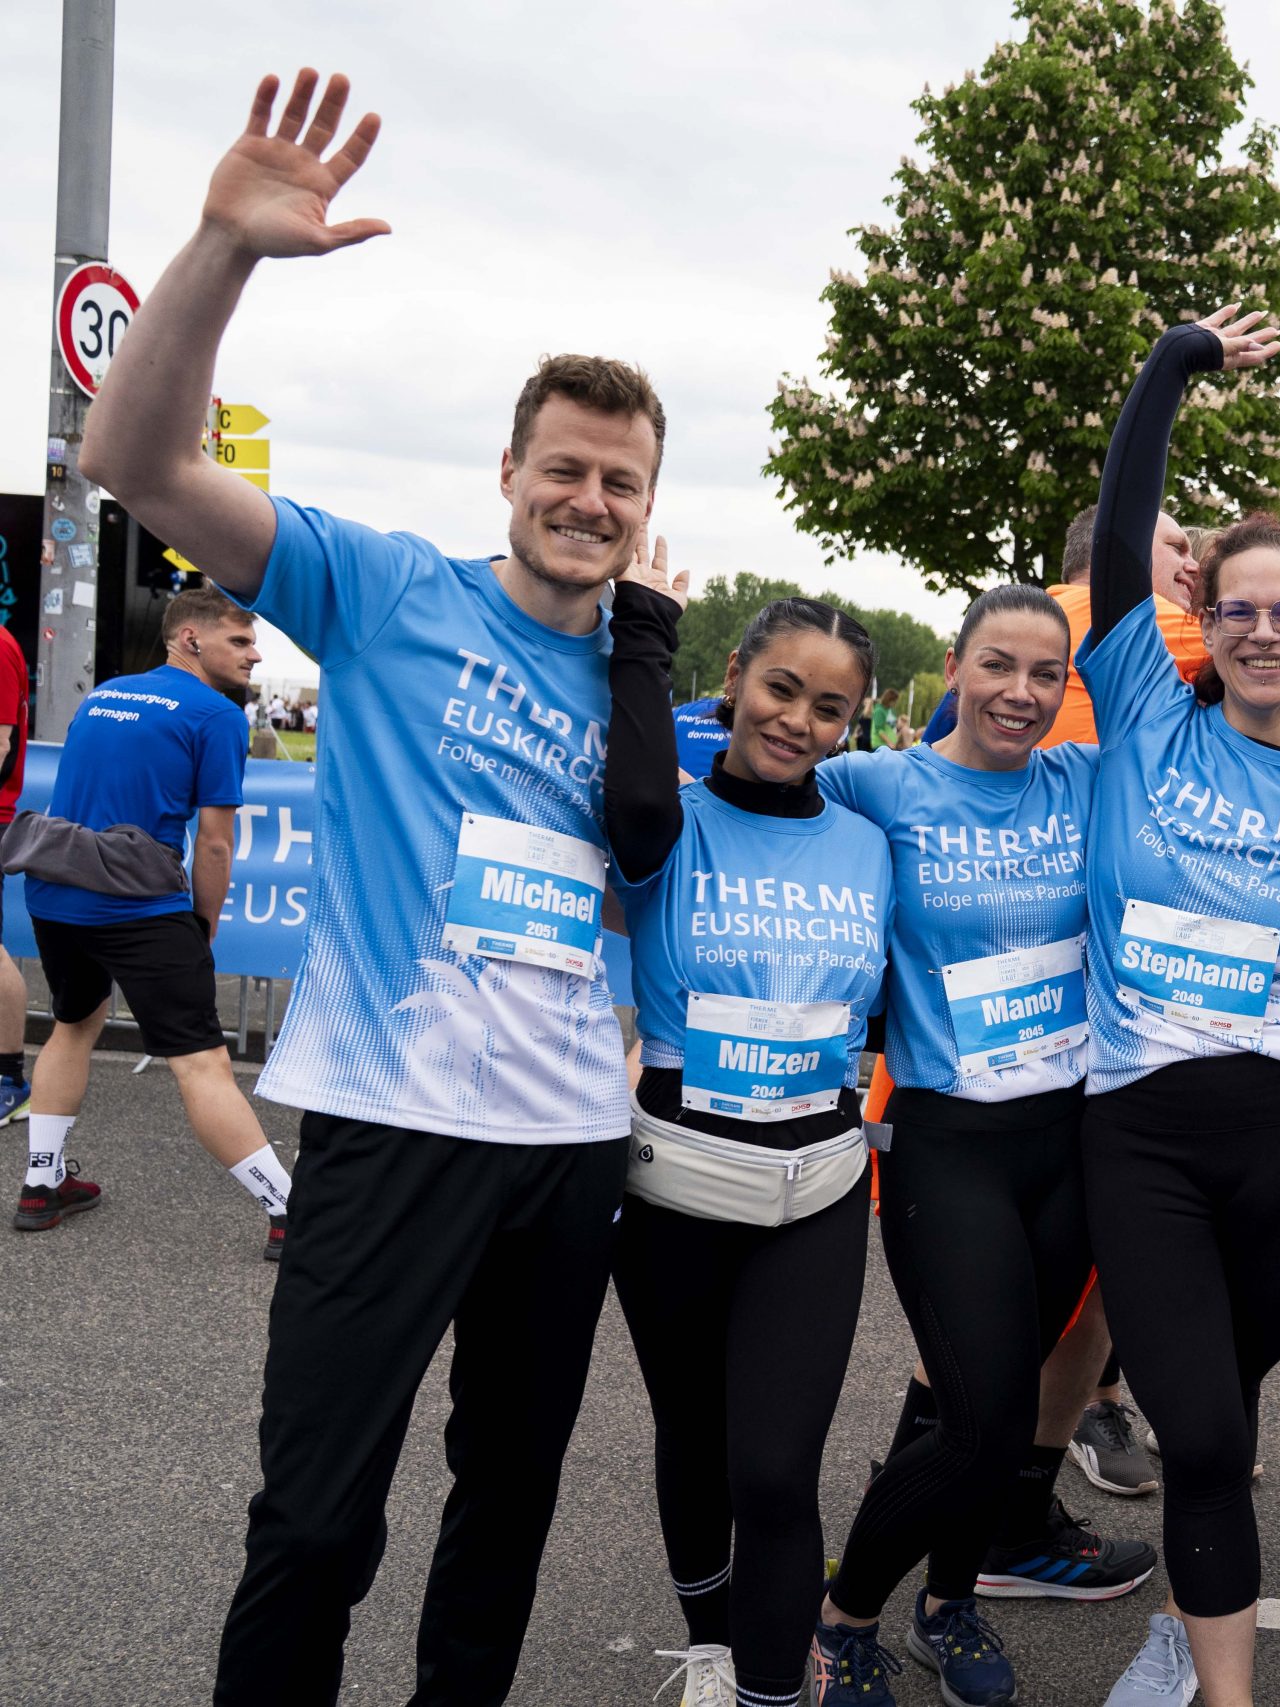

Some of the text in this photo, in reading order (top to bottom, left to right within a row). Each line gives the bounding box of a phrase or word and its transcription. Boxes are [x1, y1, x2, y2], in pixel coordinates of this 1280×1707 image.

[80, 300, 129, 359] 30
[88, 706, 139, 721] dormagen
[437, 736, 498, 773] Folge
[501, 763, 535, 788] mir
[536, 776, 568, 801] ins
[909, 813, 1082, 857] THERME
[1135, 824, 1176, 860] Folge
[1179, 852, 1212, 876] mir
[1215, 864, 1242, 888] ins
[480, 866, 596, 924] Michael
[692, 870, 877, 925] THERME
[923, 891, 973, 911] Folge
[977, 888, 1005, 906] mir
[1008, 887, 1032, 903] ins
[525, 921, 559, 940] 2051
[691, 912, 879, 953] EUSKIRCHEN
[695, 944, 748, 967] Folge
[753, 948, 783, 966] mir
[787, 948, 814, 967] ins
[1121, 940, 1266, 993] Stephanie
[981, 985, 1064, 1027] Mandy
[1171, 989, 1203, 1006] 2049
[1018, 1024, 1045, 1041] 2045
[1209, 1020, 1227, 1029] DKMS
[718, 1039, 821, 1076] Milzen
[751, 1084, 785, 1099] 2044
[29, 1153, 51, 1167] FS
